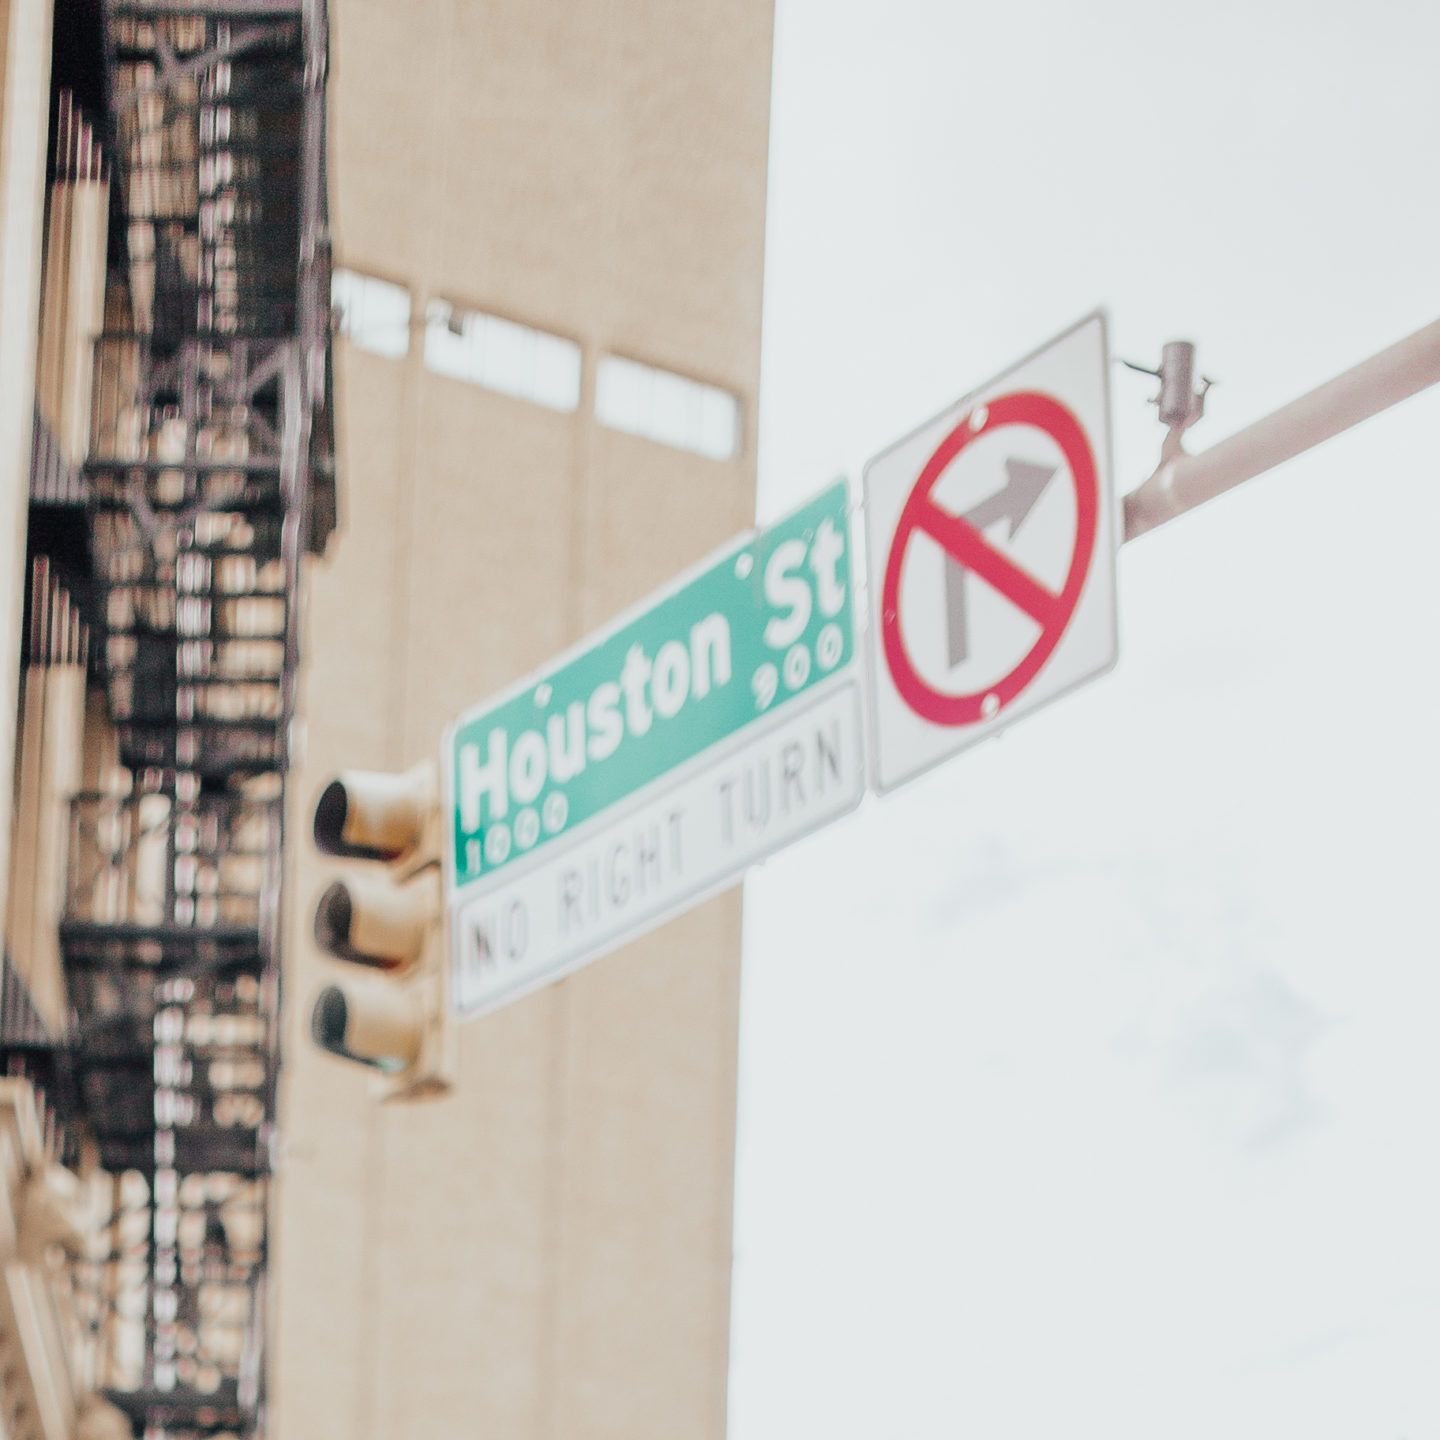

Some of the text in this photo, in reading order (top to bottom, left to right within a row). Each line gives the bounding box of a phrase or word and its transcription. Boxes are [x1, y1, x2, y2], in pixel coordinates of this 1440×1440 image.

[461, 517, 846, 834] Houston St
[751, 621, 844, 711] 900
[465, 790, 569, 876] 1000
[469, 716, 844, 975] NO RIGHT TURN
